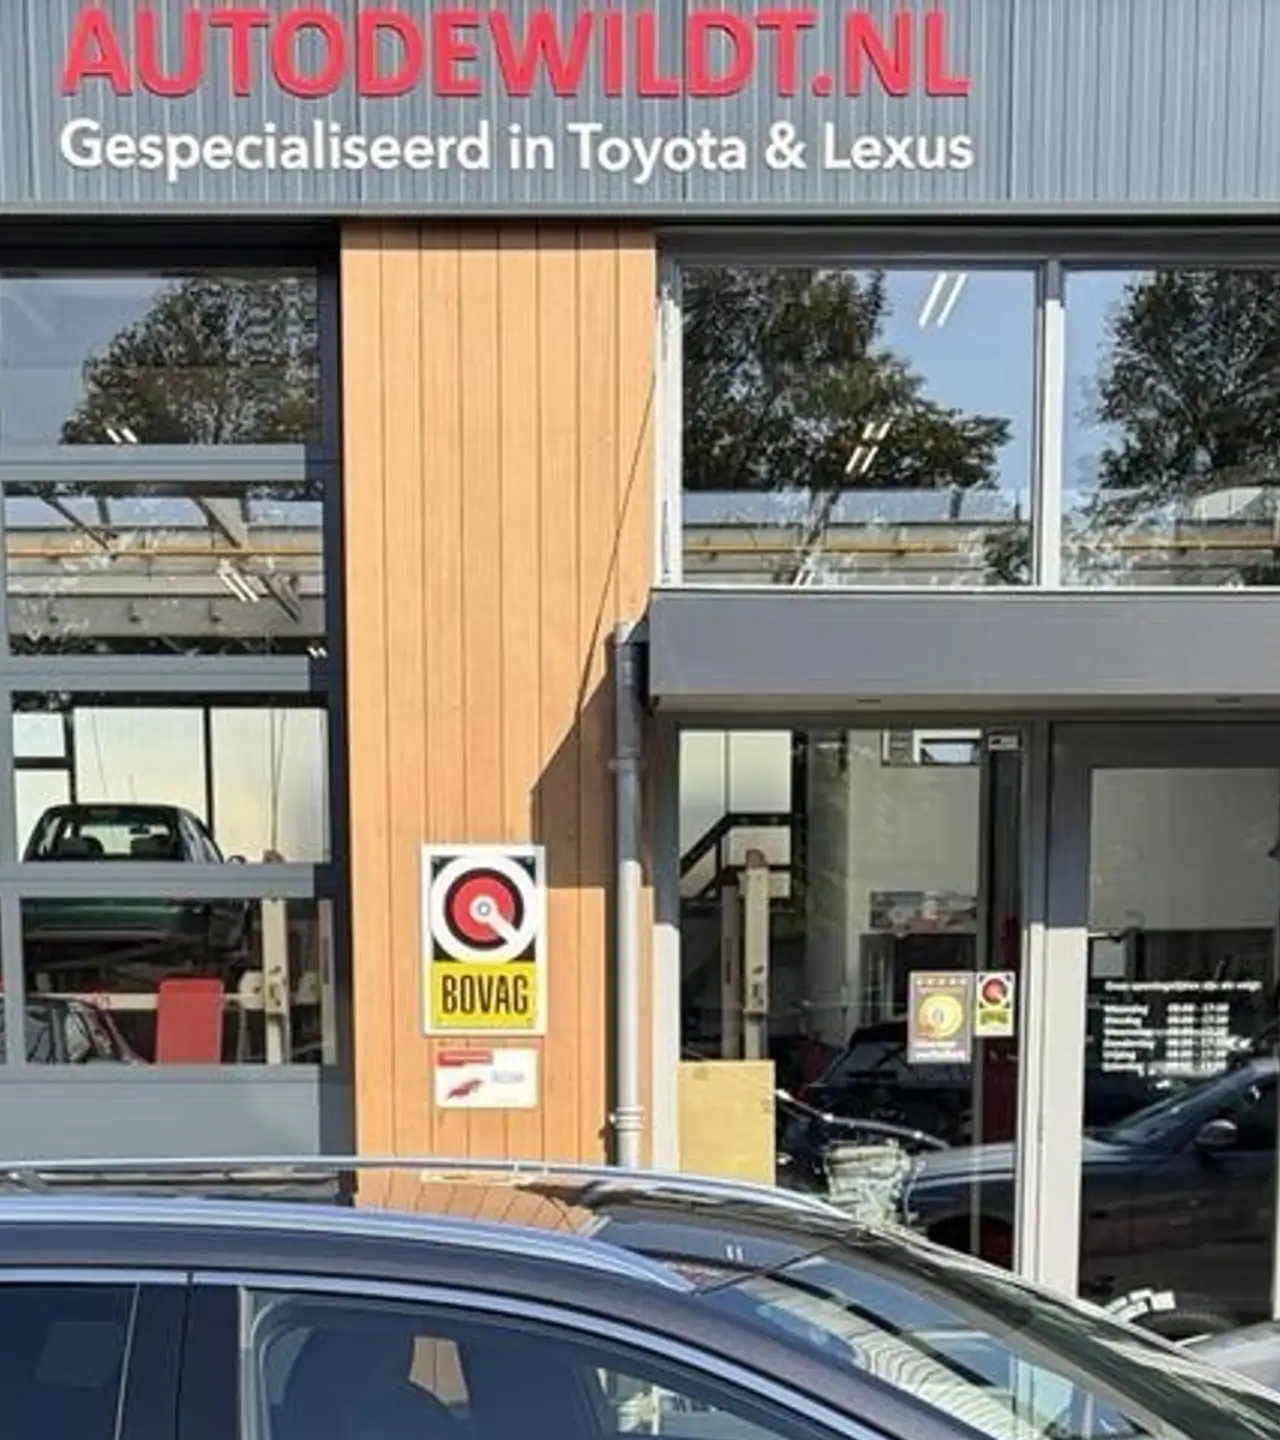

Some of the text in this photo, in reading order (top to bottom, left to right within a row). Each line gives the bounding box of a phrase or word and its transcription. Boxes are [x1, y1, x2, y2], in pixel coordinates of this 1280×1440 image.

[61, 8, 971, 97] AUTODEWILDT.NL
[59, 117, 974, 184] Gespecialiseerd in Toyota & Lexus
[441, 974, 528, 1015] BOVAG
